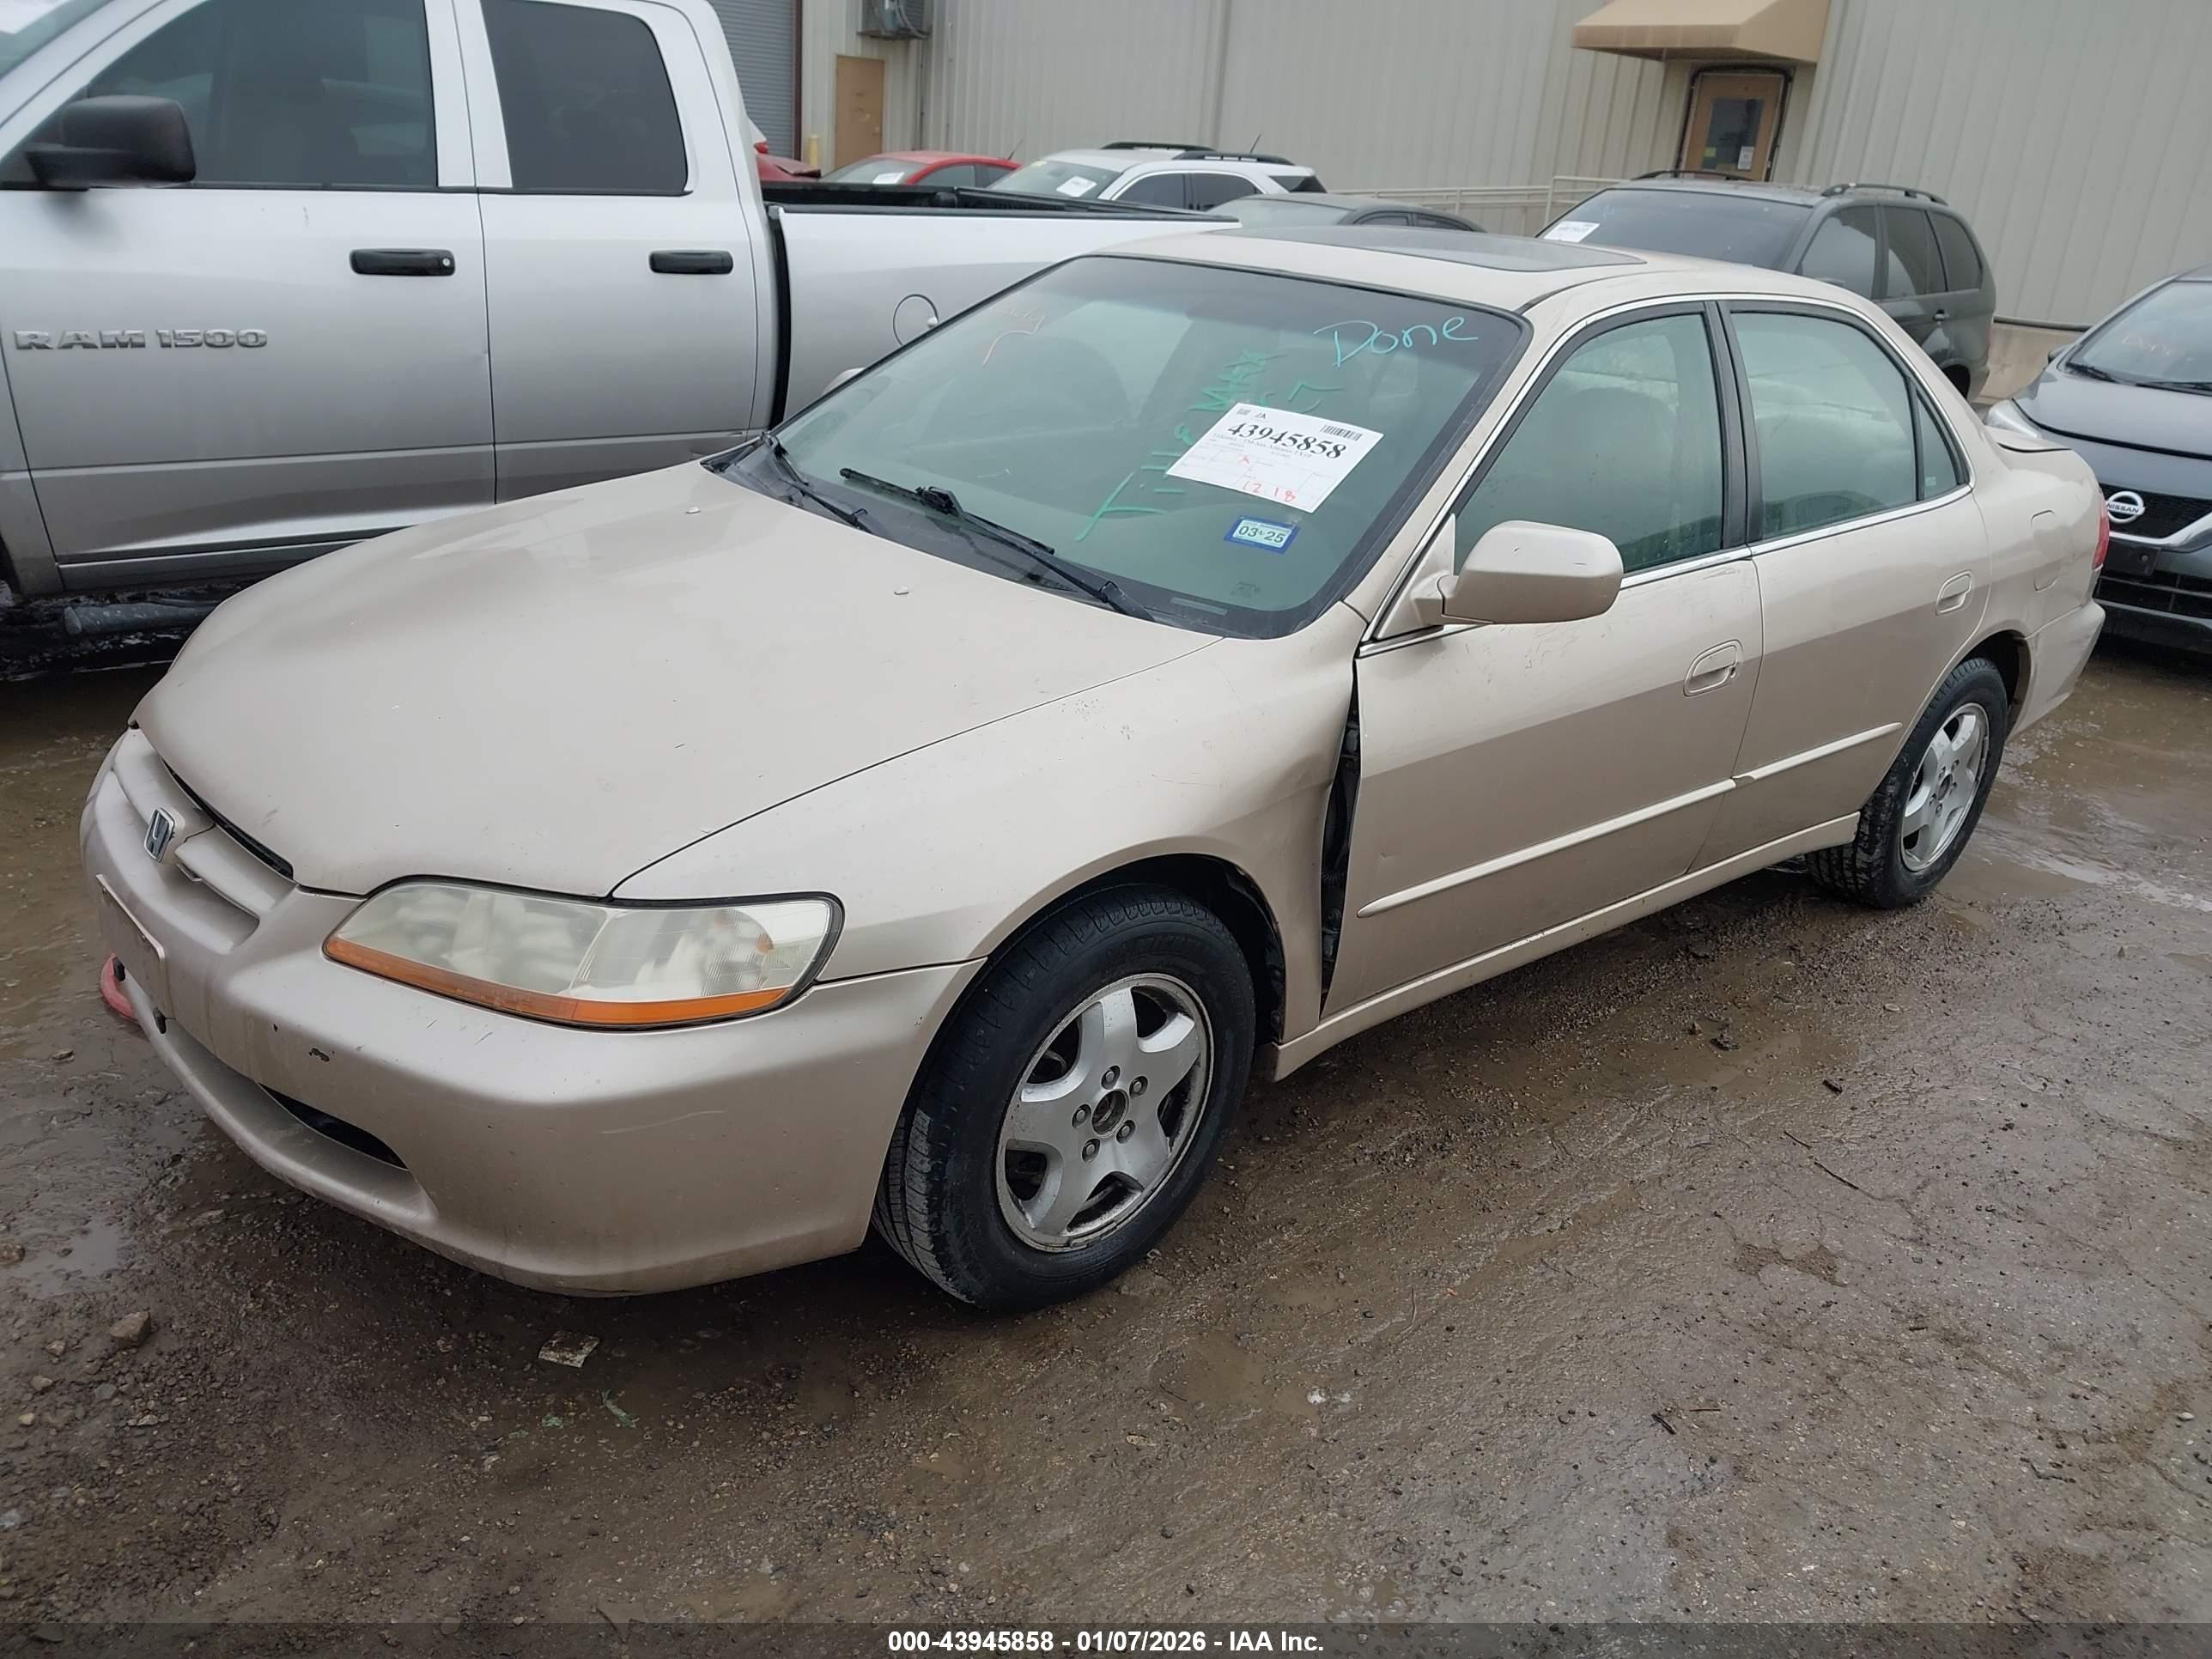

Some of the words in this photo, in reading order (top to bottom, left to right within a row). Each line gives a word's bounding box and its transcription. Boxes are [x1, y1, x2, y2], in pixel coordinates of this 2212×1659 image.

[13, 329, 147, 350] RAM
[155, 328, 268, 349] 1500
[1313, 316, 1480, 368] Done
[1227, 422, 1347, 459] 43945858
[2106, 502, 2140, 514] NISSAN
[1238, 526, 1259, 538] 03
[1263, 531, 1286, 544] 25
